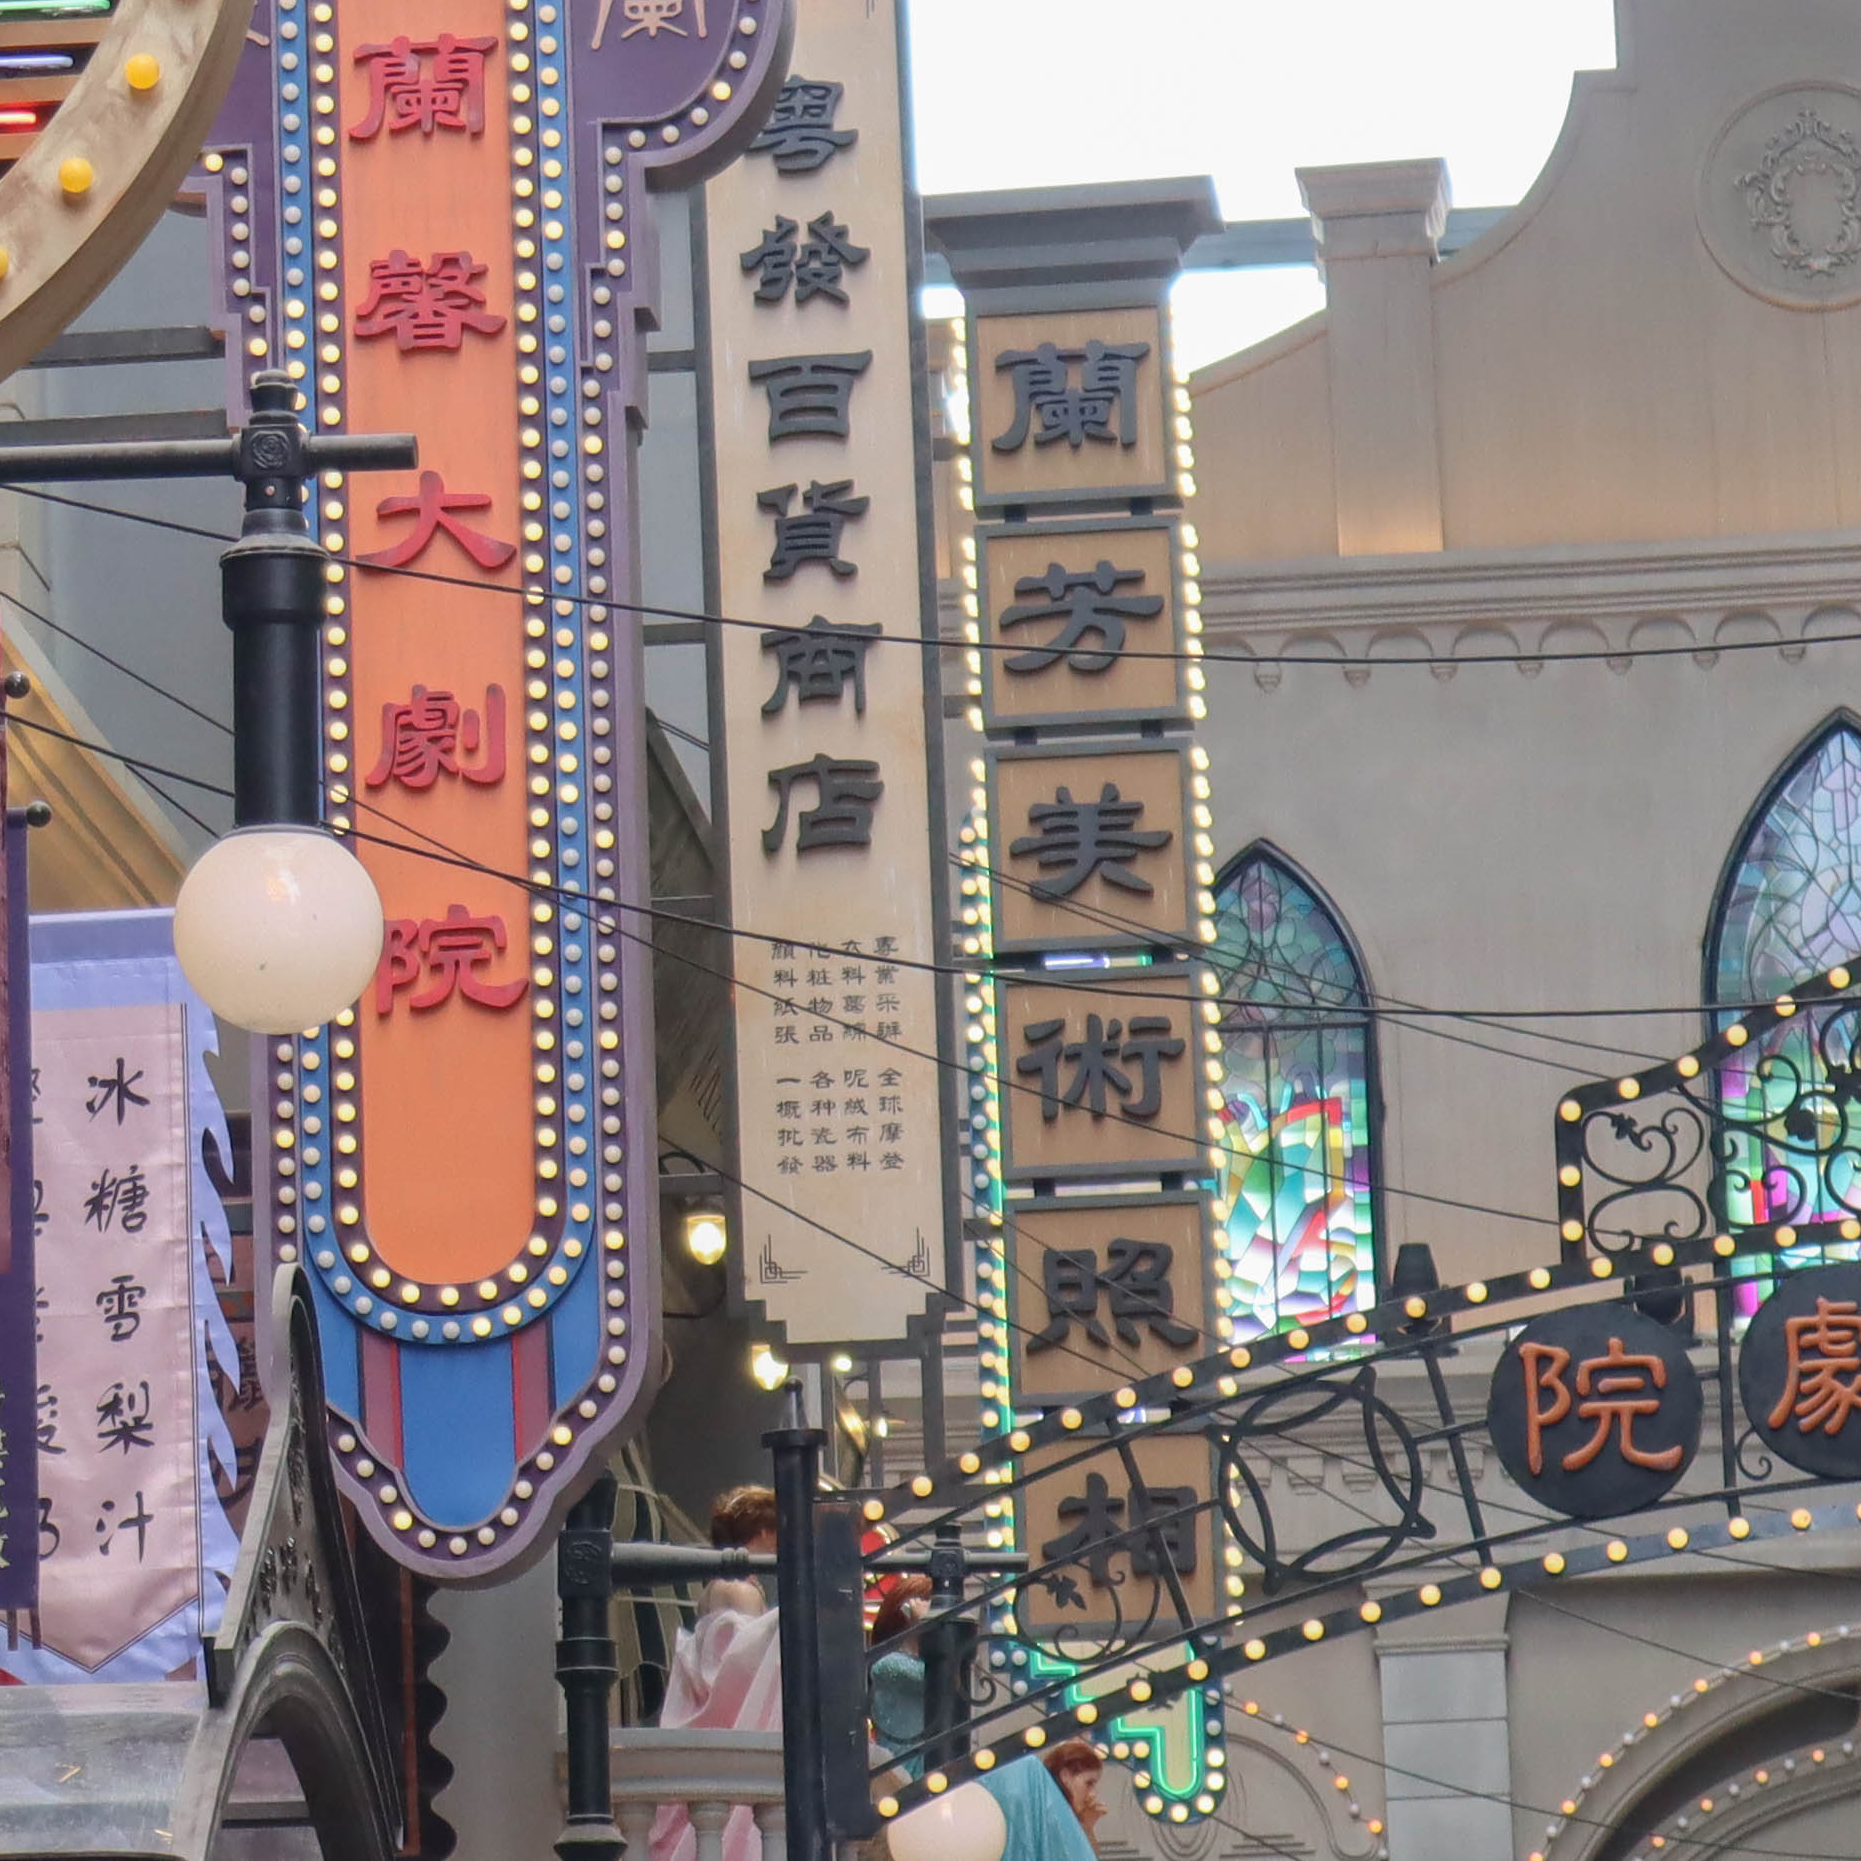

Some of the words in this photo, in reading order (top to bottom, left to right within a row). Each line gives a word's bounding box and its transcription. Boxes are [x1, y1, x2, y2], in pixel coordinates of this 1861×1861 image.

[348, 32, 529, 1019] 蘭馨大劇院
[991, 339, 1203, 1590] 蘭芳美術照相
[83, 1056, 154, 1565] 冰糖雪梨汁
